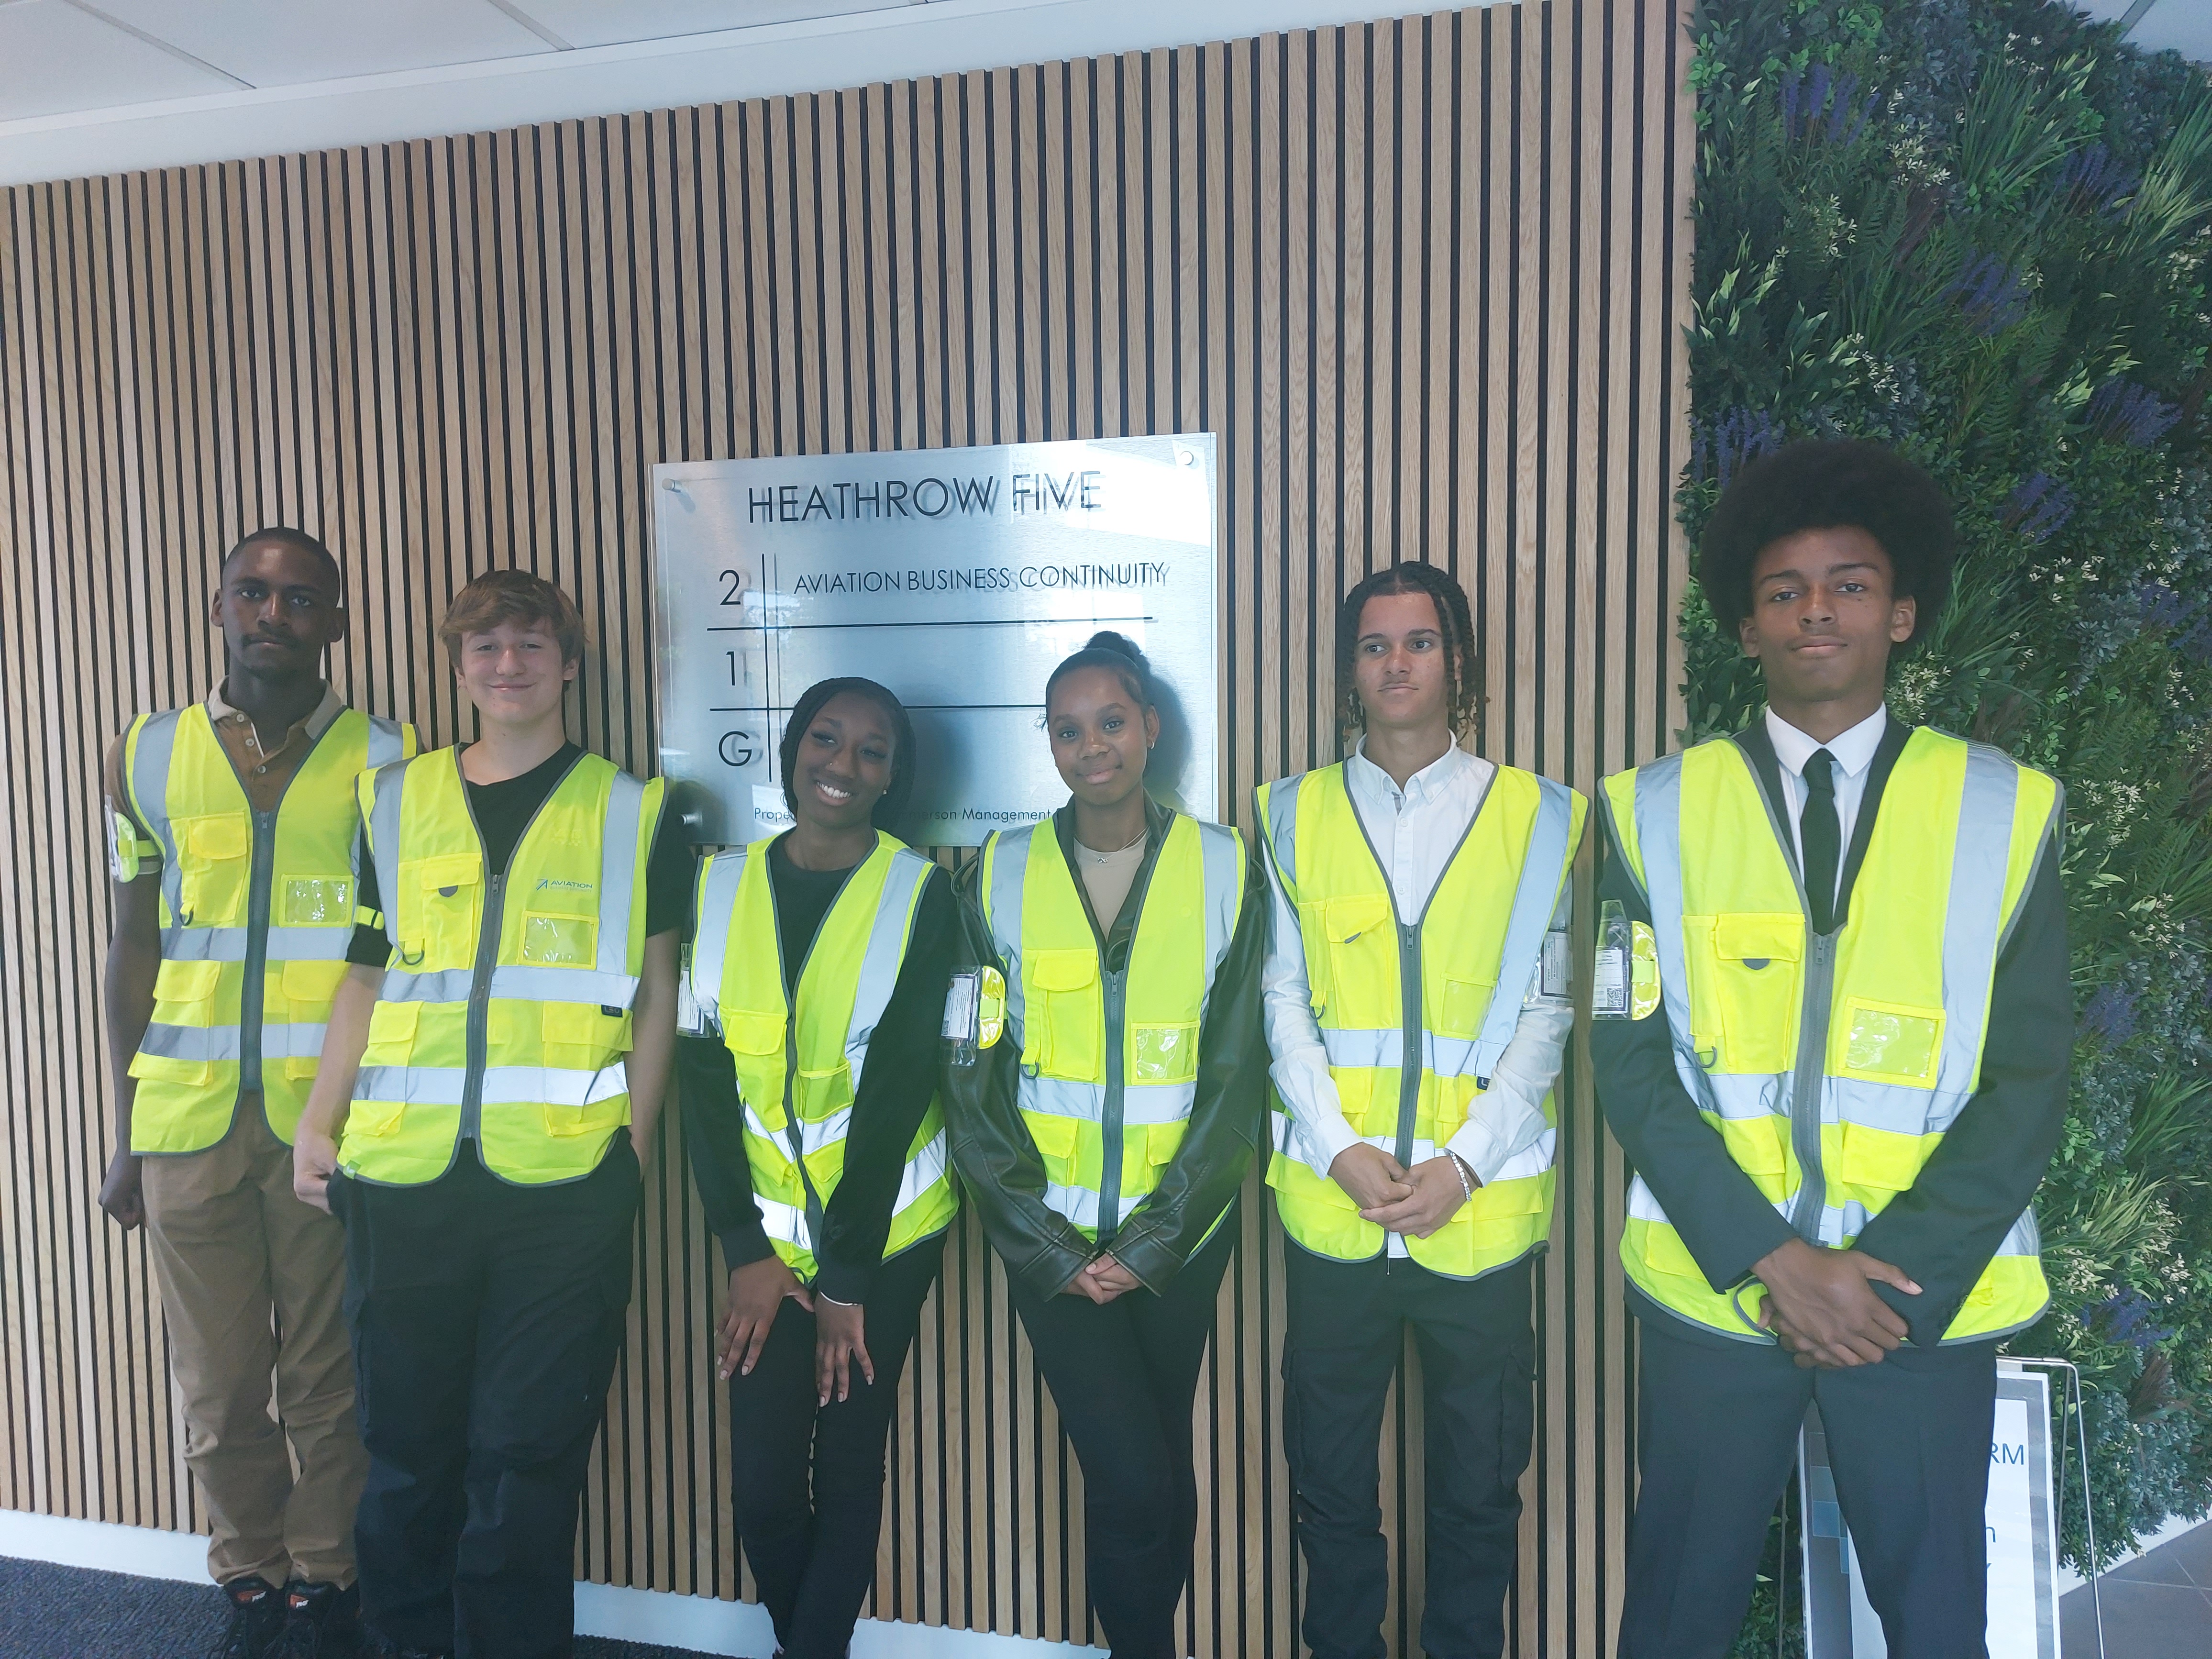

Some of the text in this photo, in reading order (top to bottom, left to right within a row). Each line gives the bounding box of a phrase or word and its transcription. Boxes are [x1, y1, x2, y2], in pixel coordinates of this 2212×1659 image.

[749, 471, 1101, 523] HEATHROW FIVE
[719, 569, 741, 606] 2
[794, 562, 1165, 594] AVIATION BUSINESS CONTINUITY
[726, 651, 735, 686] 1
[719, 730, 752, 766] G
[754, 807, 1051, 823] Prope merson Management
[550, 880, 593, 888] AVIATION
[1991, 1443, 2024, 1465] RM
